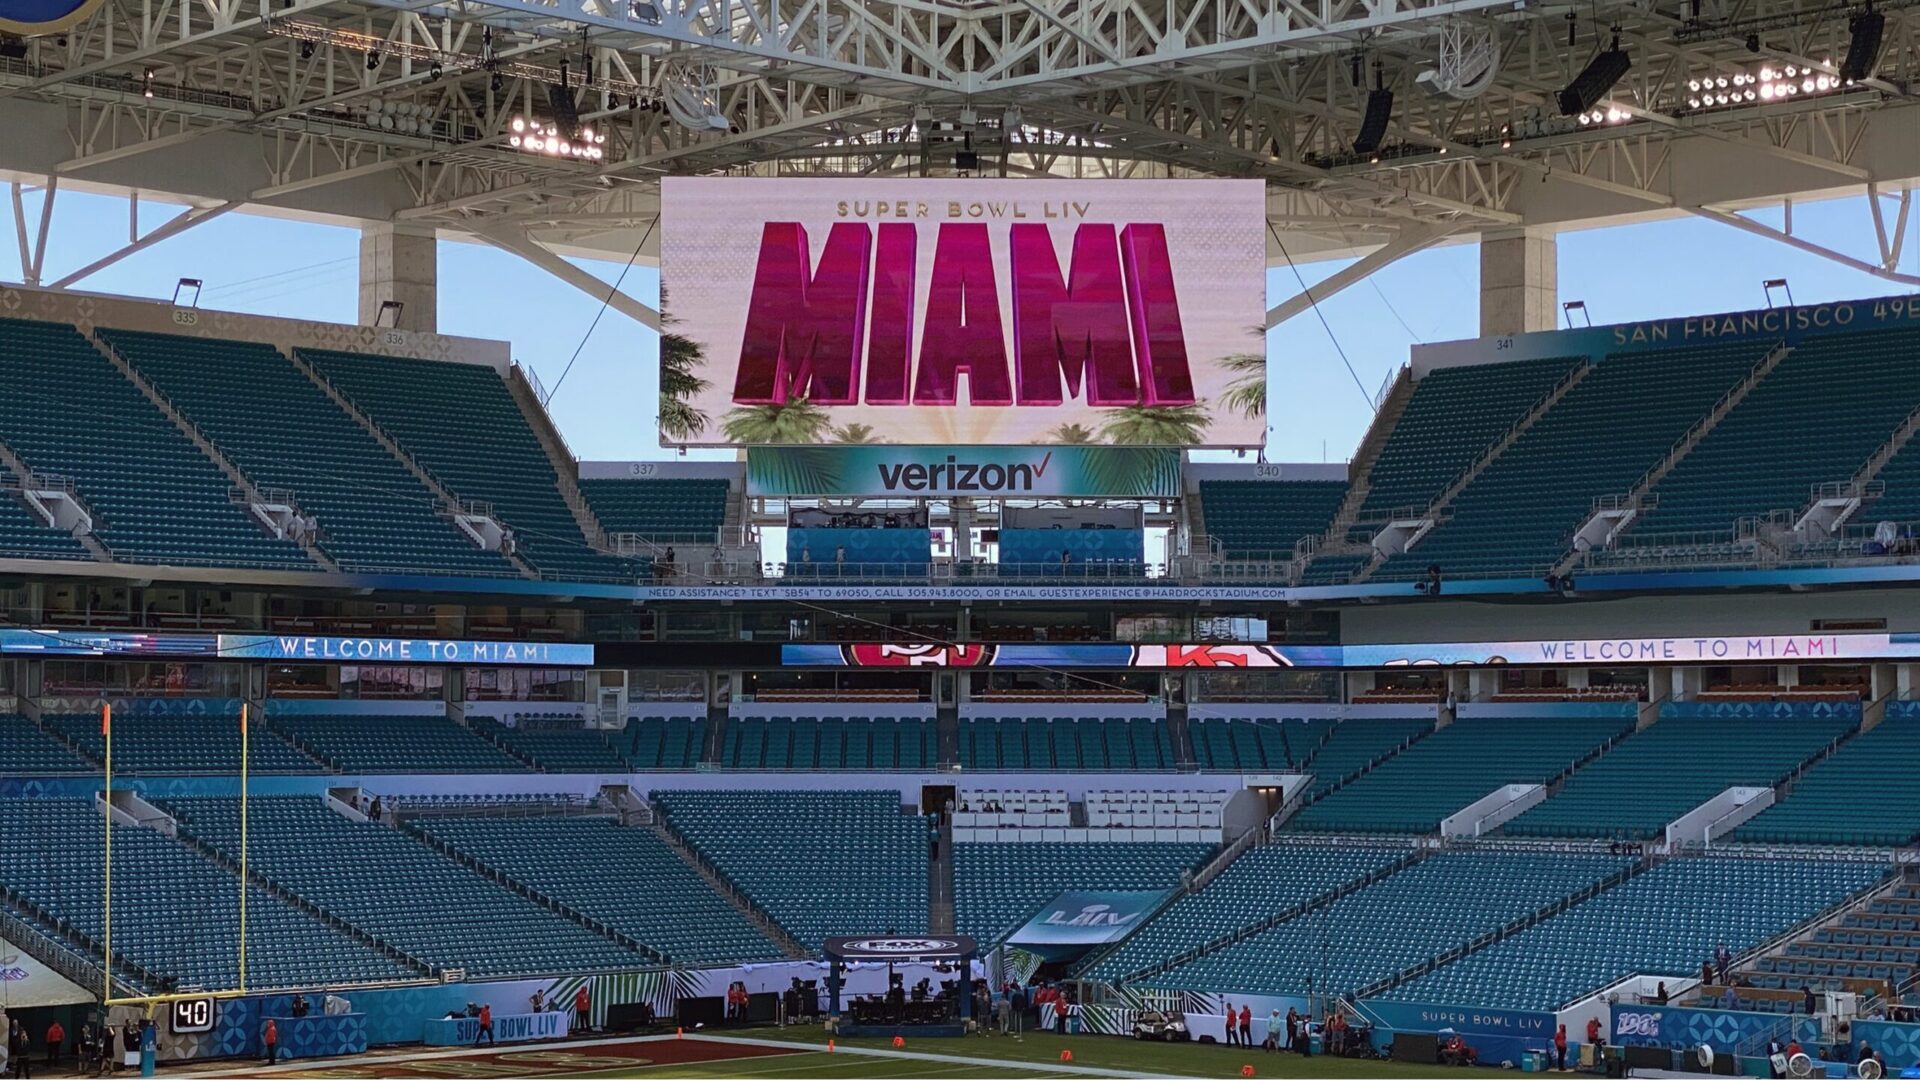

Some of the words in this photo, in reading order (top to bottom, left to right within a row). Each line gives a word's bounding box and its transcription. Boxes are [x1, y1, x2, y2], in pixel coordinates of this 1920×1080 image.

[837, 201, 929, 218] SUPER
[947, 201, 1026, 218] BOWL
[1044, 201, 1091, 218] LIV
[175, 311, 196, 324] 335
[732, 222, 1196, 407] MIAMI
[1613, 323, 1668, 345] SAN
[1684, 304, 1855, 339] FRANCISCO
[386, 333, 404, 345] 336
[1496, 339, 1513, 350] 341
[632, 463, 654, 475] 337
[878, 455, 1033, 491] verizon
[1256, 465, 1279, 477] 340
[648, 588, 676, 598] NEED
[679, 588, 746, 598] ASSISTANCE?
[751, 588, 777, 598] TEXT
[818, 588, 832, 598] TO
[875, 588, 903, 598] CALL
[986, 588, 1000, 598] OR
[1004, 588, 1035, 598] EMAIL
[280, 637, 412, 659] WELCOME
[428, 640, 458, 659] TO
[474, 642, 549, 660] MIAMI
[1541, 640, 1675, 660] WELCOME
[1694, 639, 1728, 658] TO
[1747, 637, 1837, 657] MIAMI
[868, 941, 931, 949] FOX
[180, 1001, 207, 1025] 40
[1422, 1011, 1466, 1023] SUPER
[1473, 1015, 1511, 1027] BOWL
[1519, 1018, 1543, 1029] LIV
[457, 1020, 496, 1041] SUPR
[500, 1017, 534, 1038] BOWL
[538, 1014, 558, 1035] LIV
